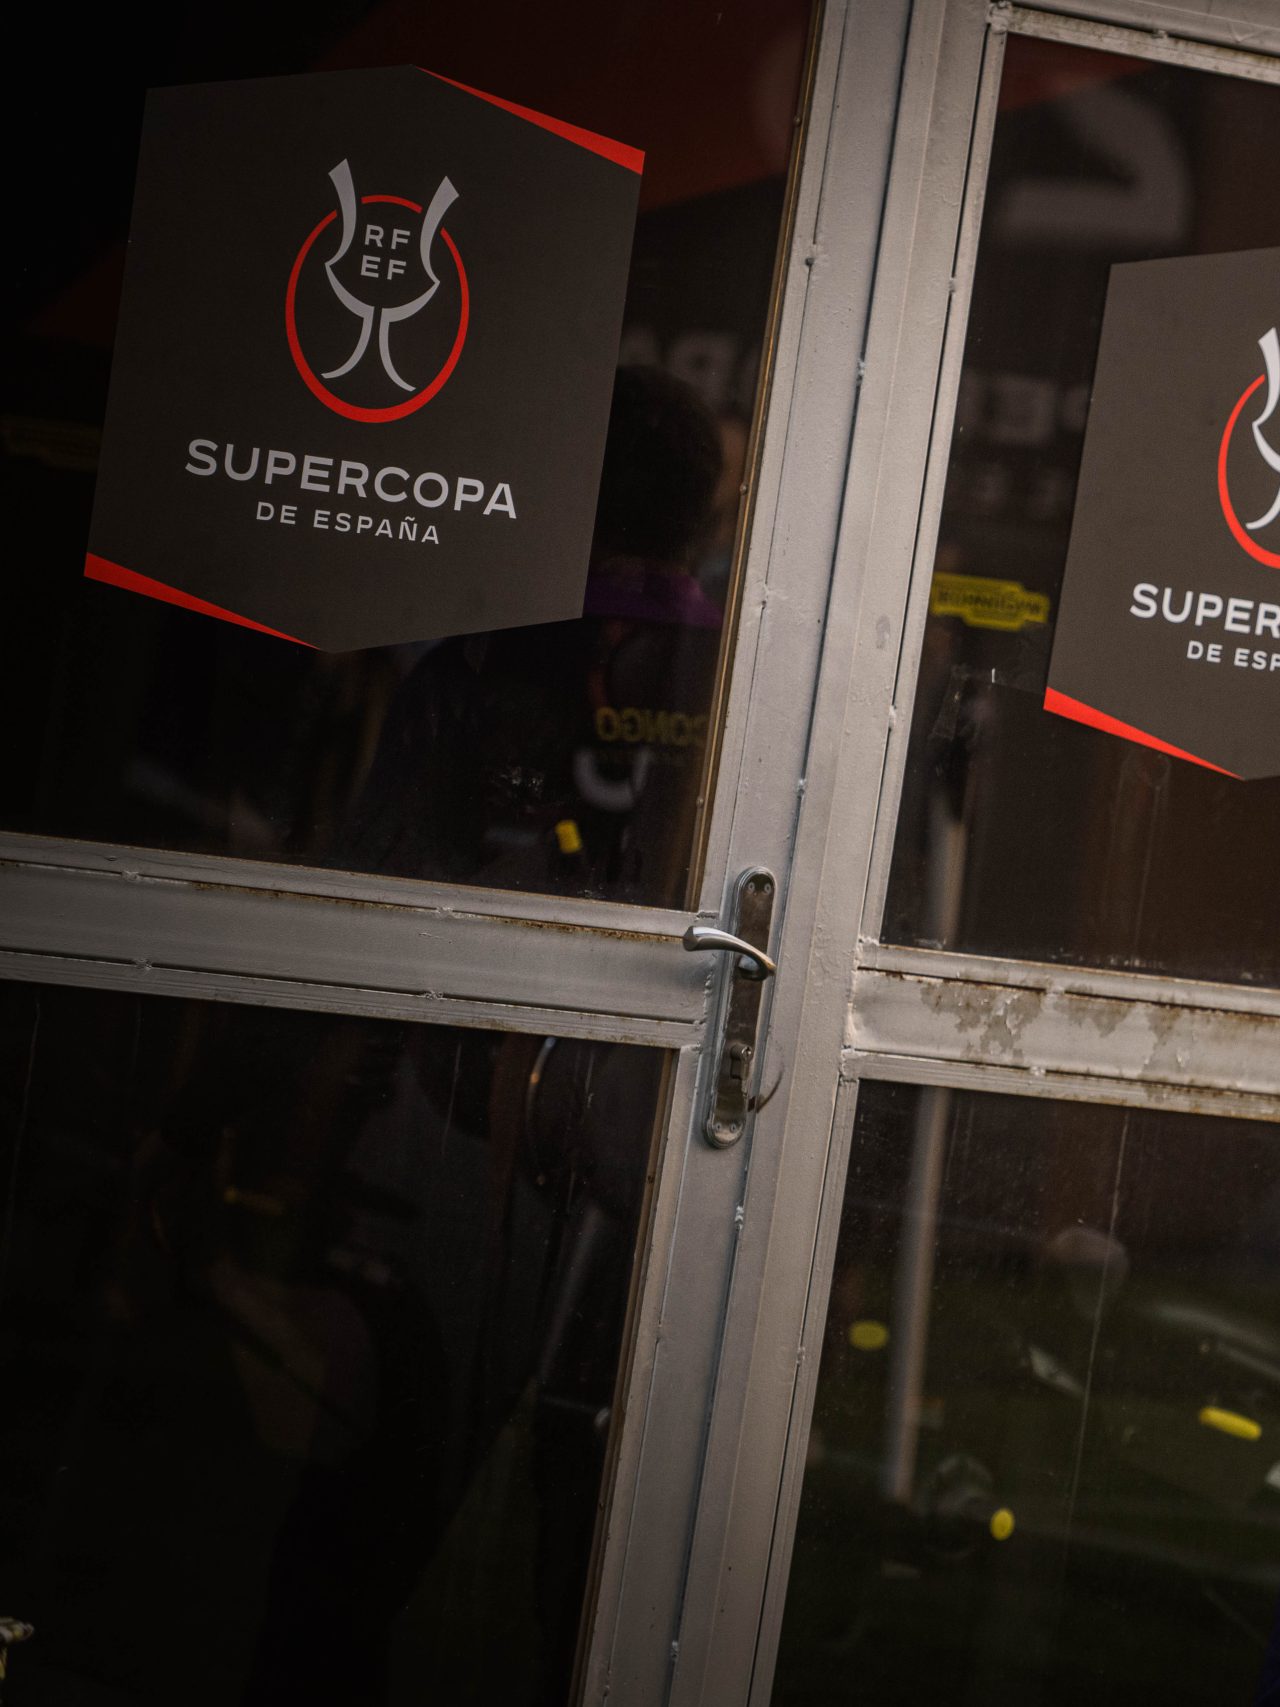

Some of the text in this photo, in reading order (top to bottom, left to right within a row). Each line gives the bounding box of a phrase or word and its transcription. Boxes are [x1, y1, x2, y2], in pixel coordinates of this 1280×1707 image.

[364, 224, 411, 250] RF
[360, 254, 407, 281] EF
[184, 438, 518, 520] SUPERCOPA
[256, 501, 440, 545] DE ESPAÑA
[1186, 640, 1223, 663] DE
